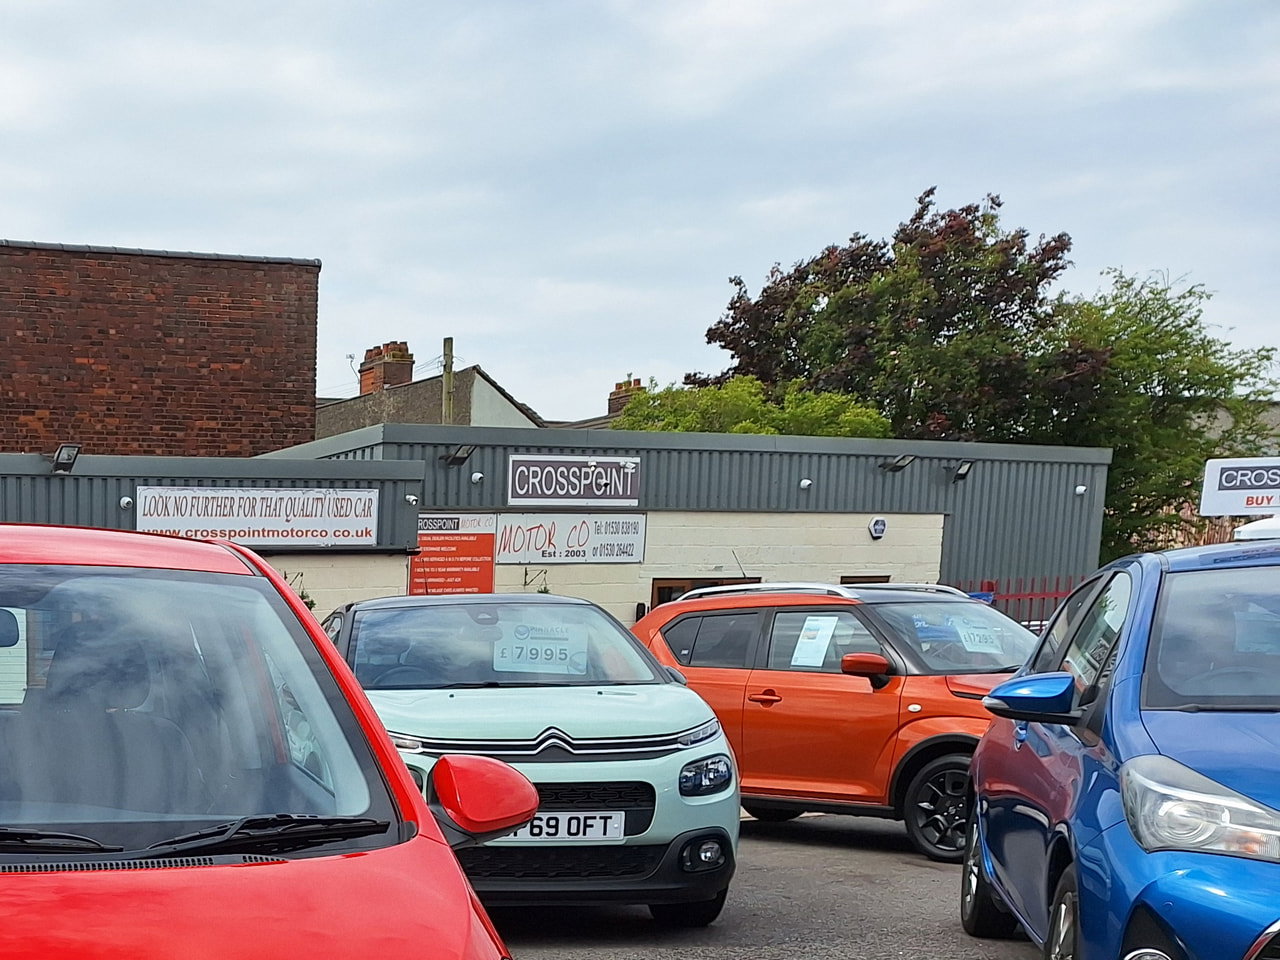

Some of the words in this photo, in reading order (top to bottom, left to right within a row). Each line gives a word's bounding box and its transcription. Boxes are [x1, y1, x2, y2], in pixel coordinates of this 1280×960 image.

[515, 466, 636, 495] CROSSPOINT
[142, 495, 171, 517] LOOK
[172, 496, 188, 517] NO
[189, 496, 235, 517] FURTHER
[236, 496, 257, 517] FOR
[259, 497, 284, 518] THAT
[285, 497, 326, 522] QUALITY
[327, 497, 353, 518] USED
[354, 497, 373, 518] CAR
[1245, 495, 1274, 506] BUY
[418, 518, 459, 530] ROSSPOINT
[497, 521, 557, 556] MOTOR
[567, 520, 590, 548] CO
[541, 550, 557, 558] Est
[564, 550, 587, 558] 2003
[567, 816, 613, 836] OFT
